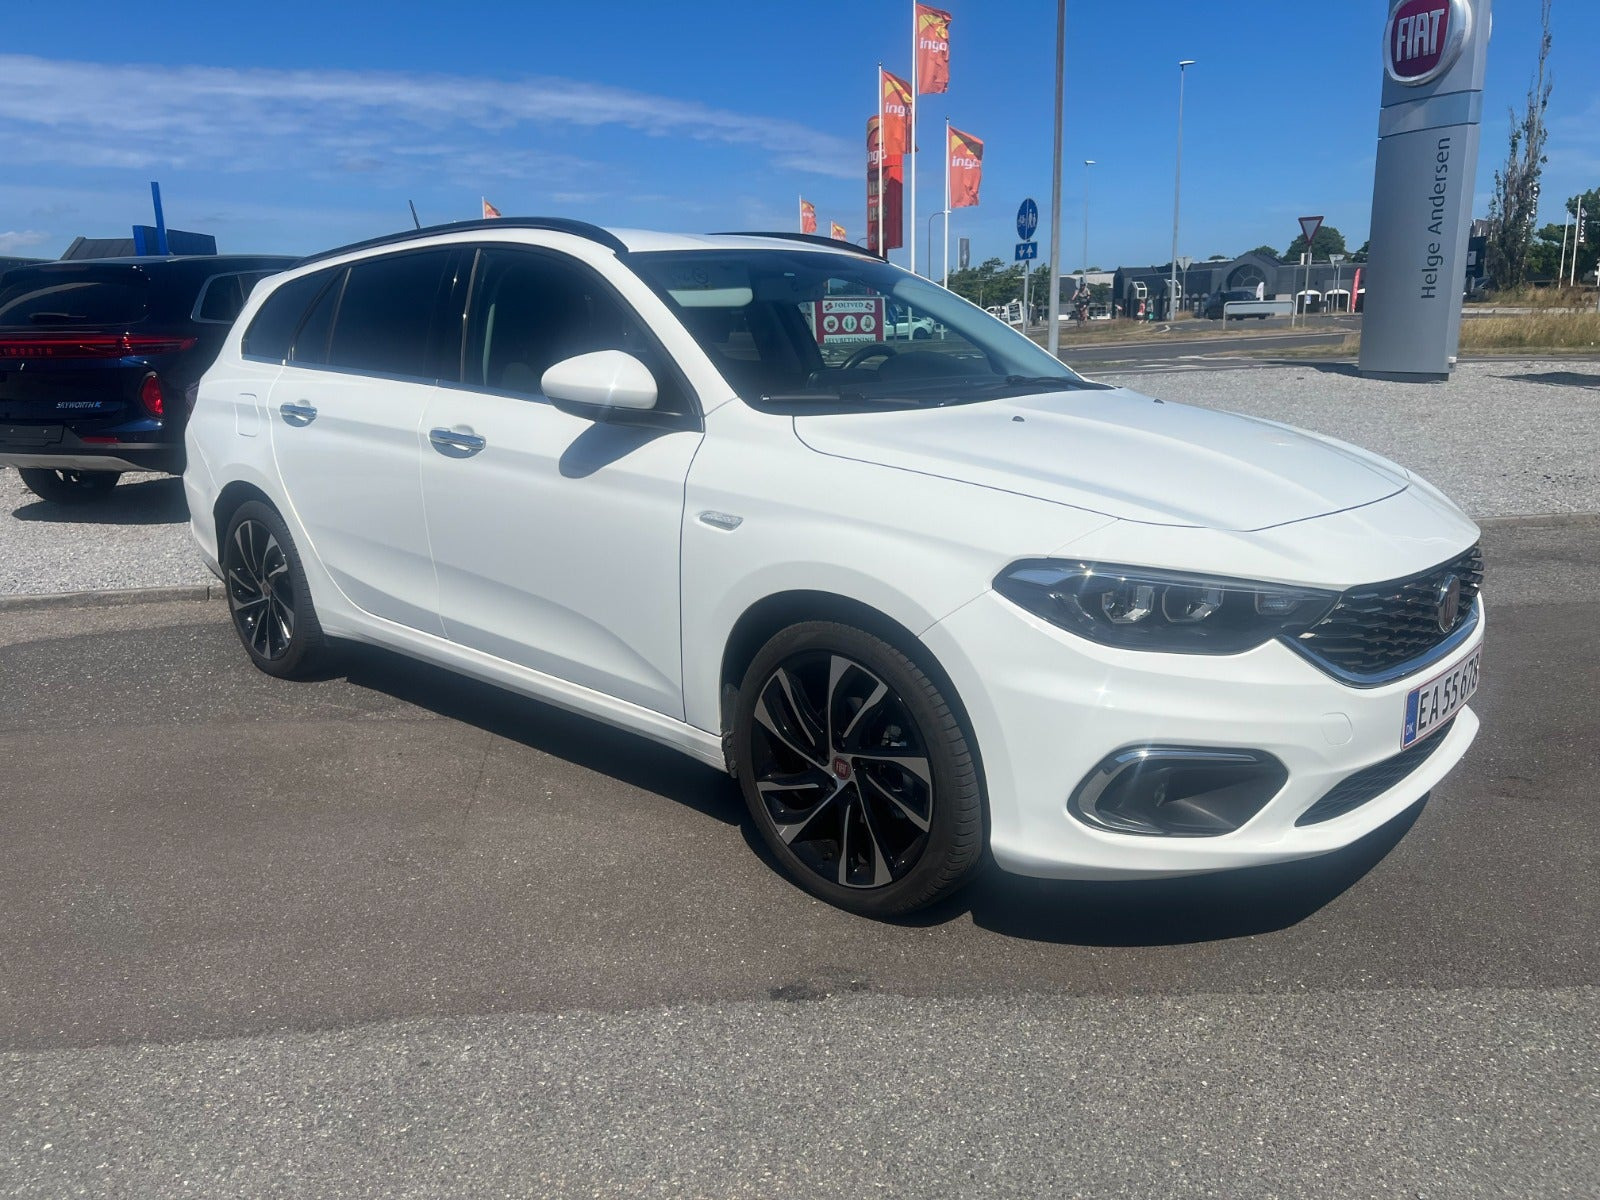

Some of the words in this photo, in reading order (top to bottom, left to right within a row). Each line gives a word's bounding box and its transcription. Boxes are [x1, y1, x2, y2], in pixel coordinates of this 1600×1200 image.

[920, 37, 948, 53] ingo
[1396, 8, 1445, 62] FIAT
[867, 149, 887, 165] ngo
[1428, 137, 1451, 235] Andersen
[1421, 242, 1444, 299] Helge
[1418, 685, 1439, 731] EA
[1442, 670, 1460, 716] 55
